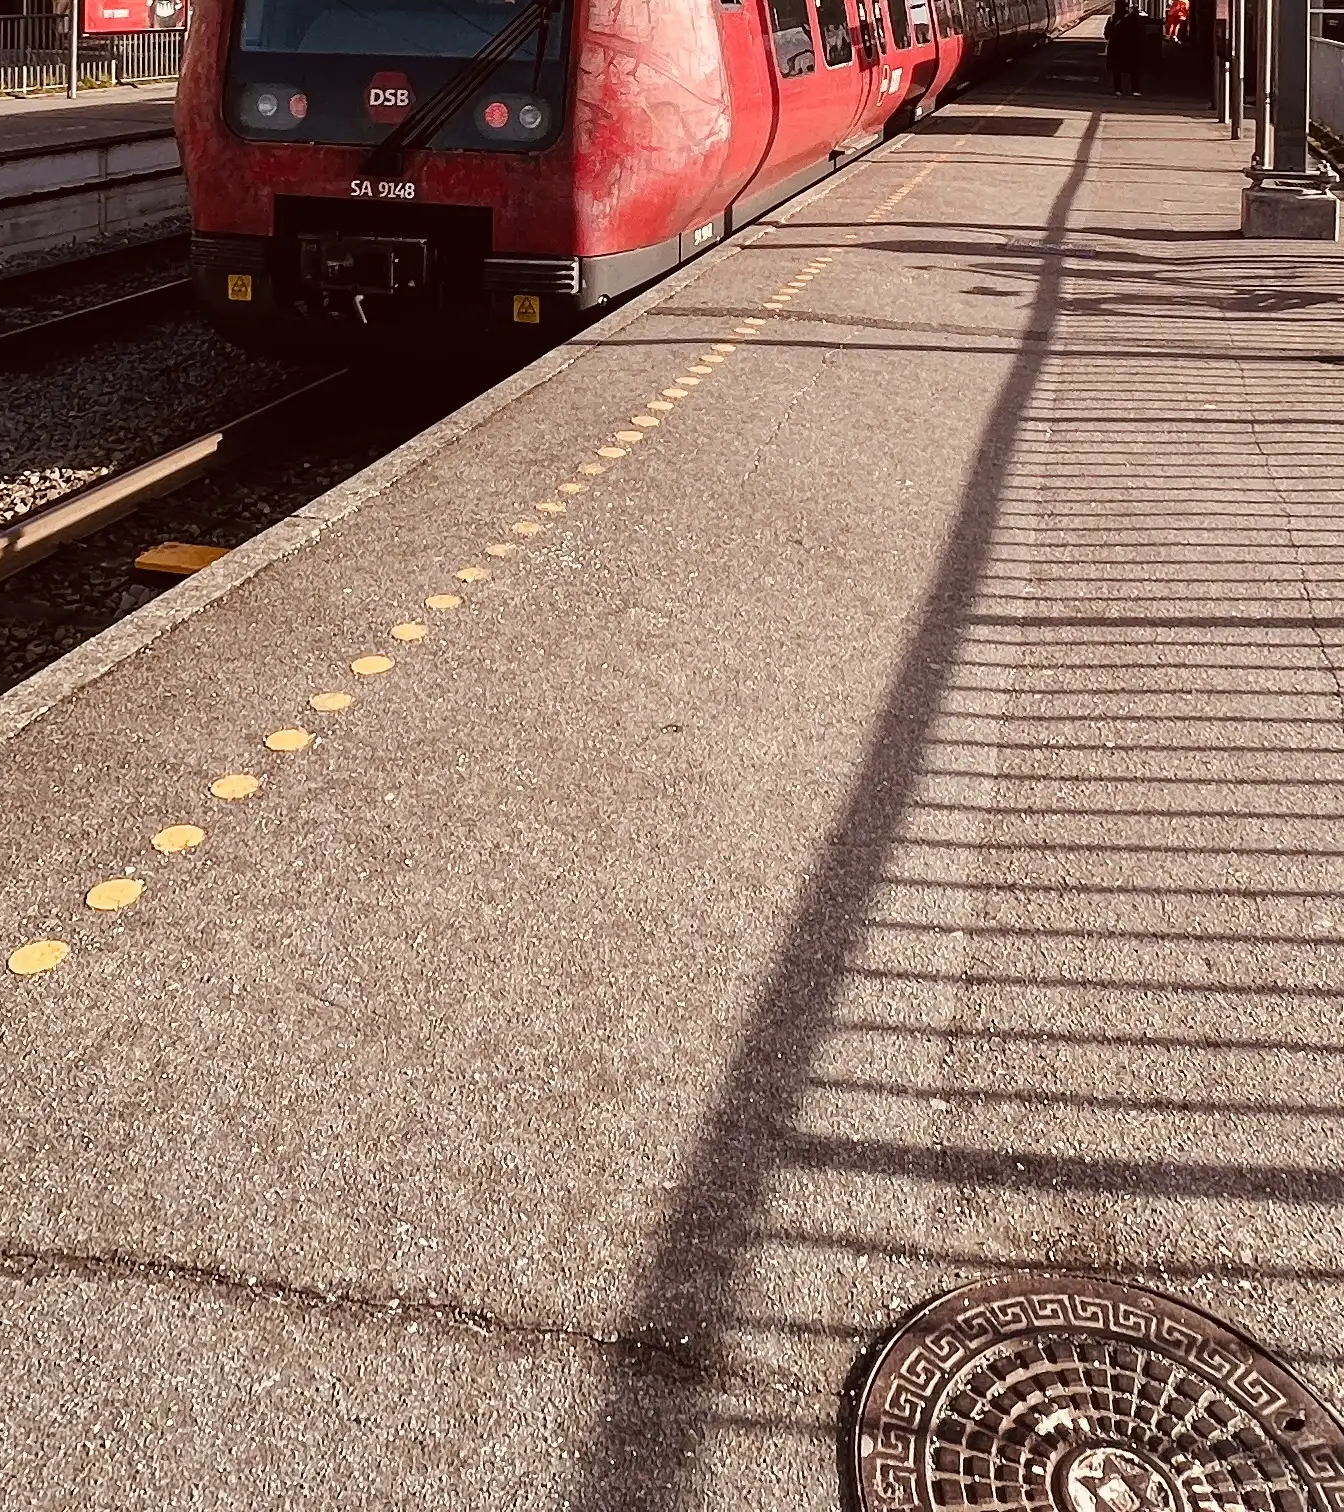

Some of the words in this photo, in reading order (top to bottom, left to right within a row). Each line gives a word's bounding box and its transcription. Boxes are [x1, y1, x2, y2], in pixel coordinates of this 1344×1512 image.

[369, 88, 409, 106] DSB
[350, 180, 373, 197] SA
[378, 181, 415, 199] 9148
